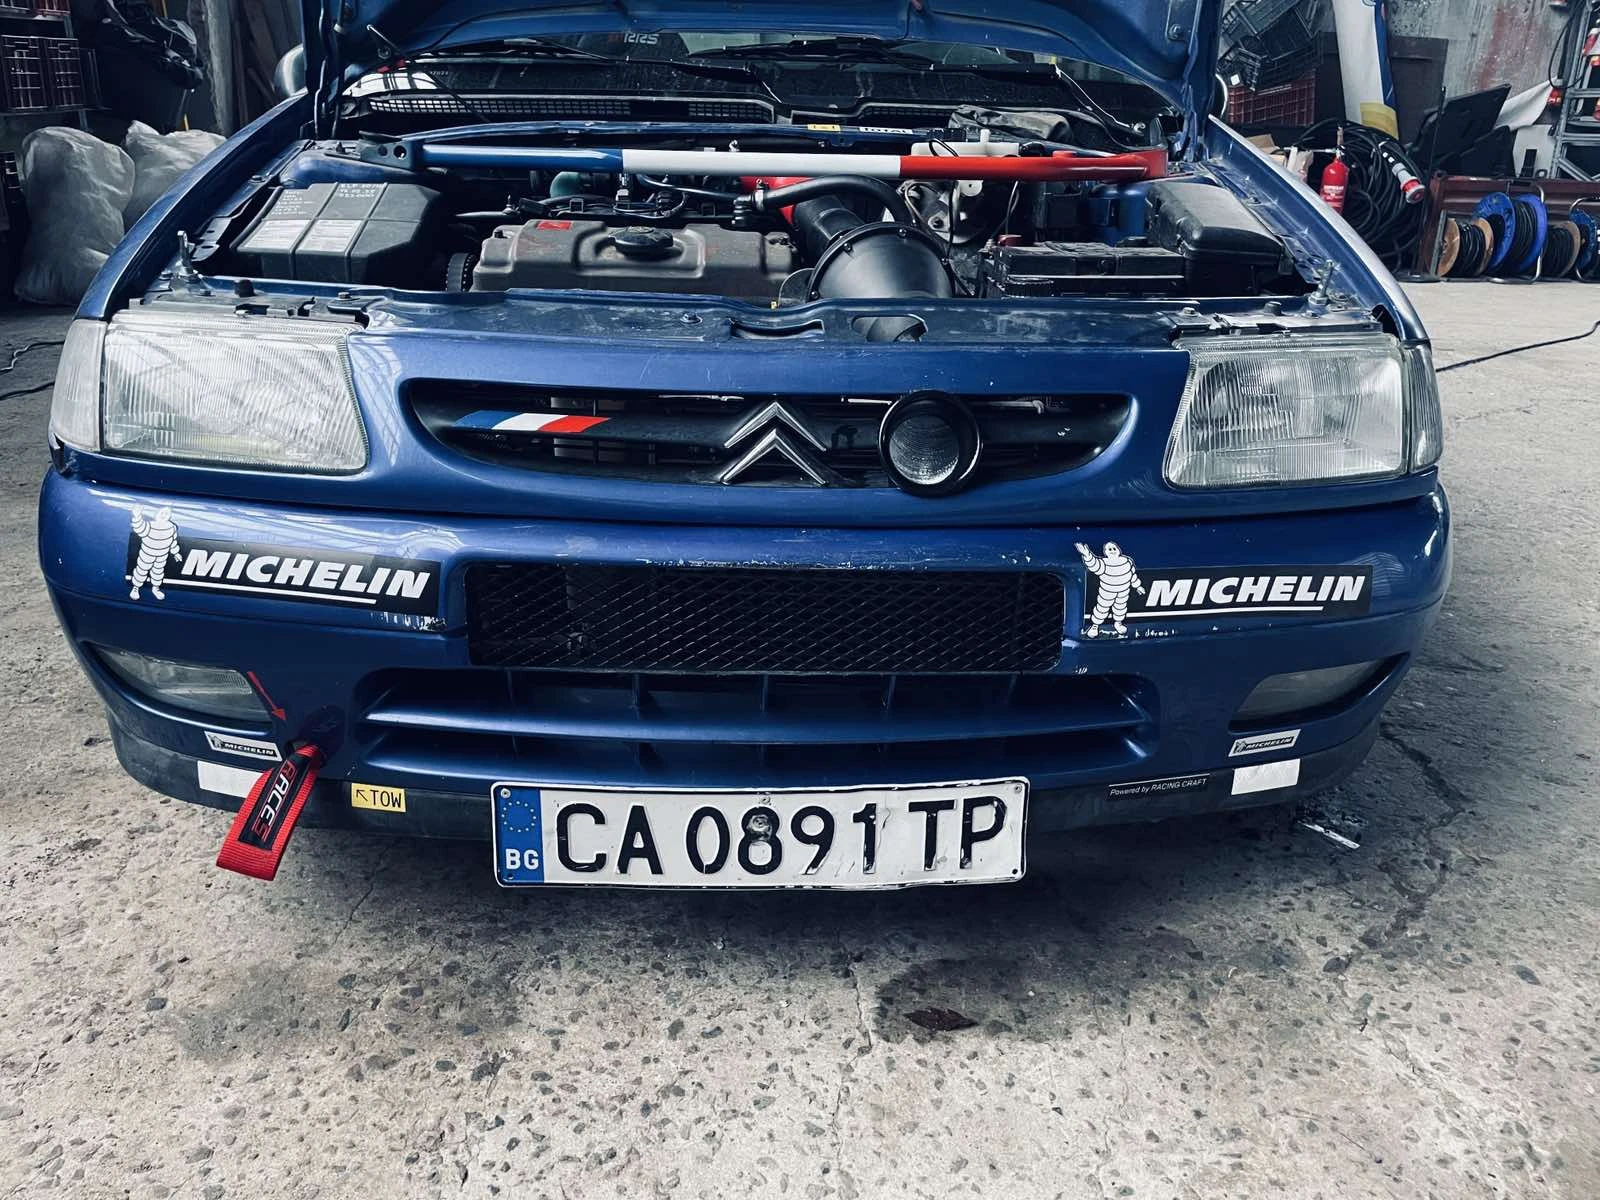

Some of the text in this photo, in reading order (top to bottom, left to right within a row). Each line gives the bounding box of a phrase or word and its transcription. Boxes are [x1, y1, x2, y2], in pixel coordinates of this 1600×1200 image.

[180, 548, 431, 599] MICHELIN
[1145, 575, 1366, 608] MICHELIN
[224, 742, 275, 756] MICHELIN
[1245, 736, 1292, 749] MICHELIN
[1110, 778, 1207, 796] Powered by RACING CRAFT
[251, 759, 298, 843] RACES
[370, 788, 402, 809] TOW
[556, 795, 1007, 876] CA 0891 TP
[505, 849, 539, 870] BG
